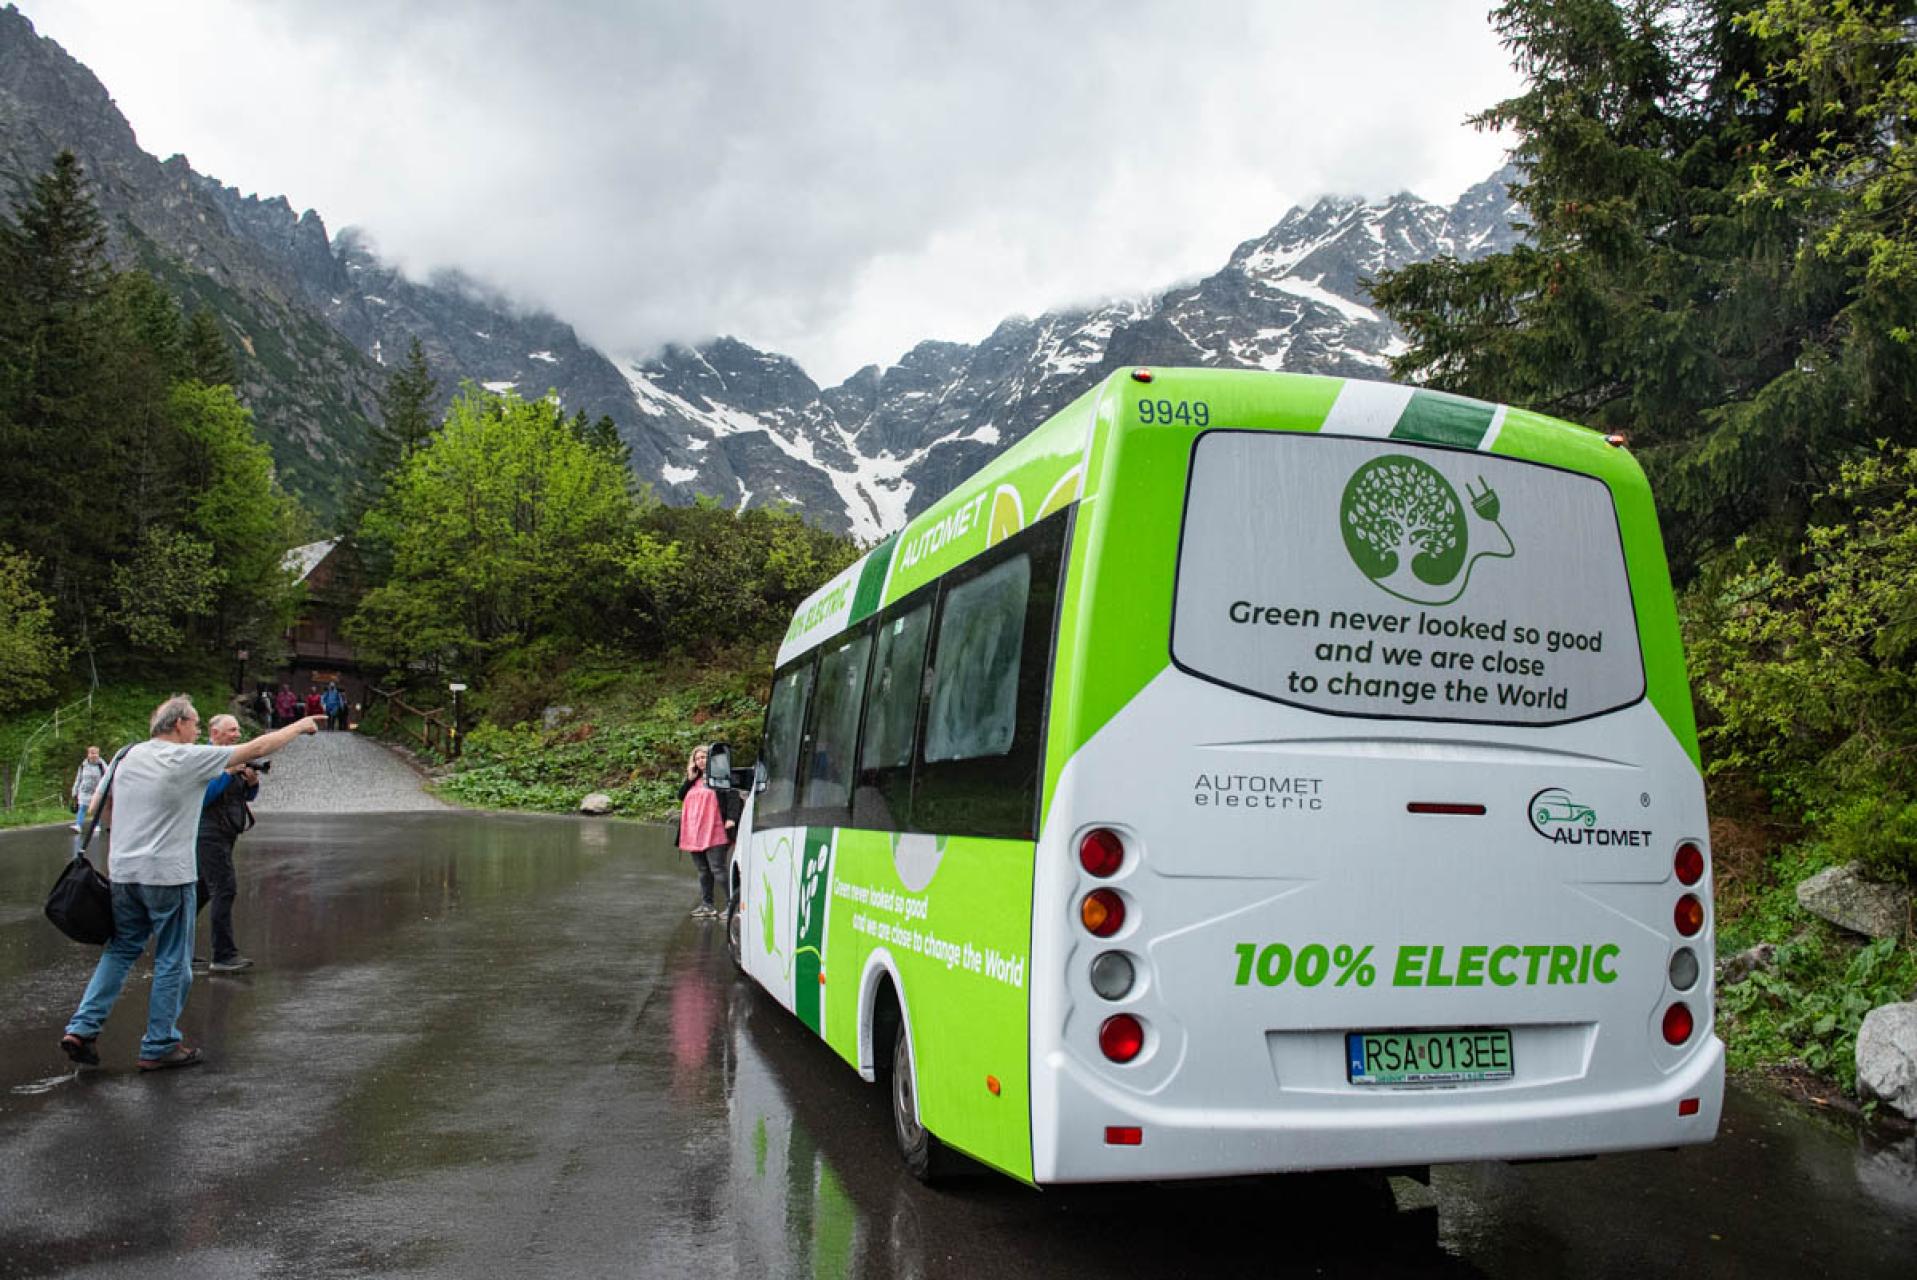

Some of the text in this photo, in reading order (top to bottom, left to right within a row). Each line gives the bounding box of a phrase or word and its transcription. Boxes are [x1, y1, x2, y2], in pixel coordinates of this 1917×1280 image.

[1138, 399, 1209, 427] 9949
[899, 492, 987, 571] AUTOMET
[1229, 600, 1602, 654] Green never looked so good
[1315, 639, 1545, 677] and we are close
[1288, 670, 1568, 710] to change the World
[1195, 774, 1323, 794] AUTOMET
[1195, 790, 1322, 810] electric
[1553, 827, 1653, 847] AUTOMET
[869, 884, 895, 912] looked
[895, 894, 905, 914] so
[905, 895, 929, 921] good
[852, 912, 866, 933] and
[891, 921, 912, 950] close
[912, 929, 923, 953] to
[924, 930, 961, 970] change
[962, 942, 982, 974] the
[985, 948, 1025, 988] World
[1234, 942, 1620, 987] 100% ELECTRIC
[1365, 1036, 1508, 1071] RSA 013EE
